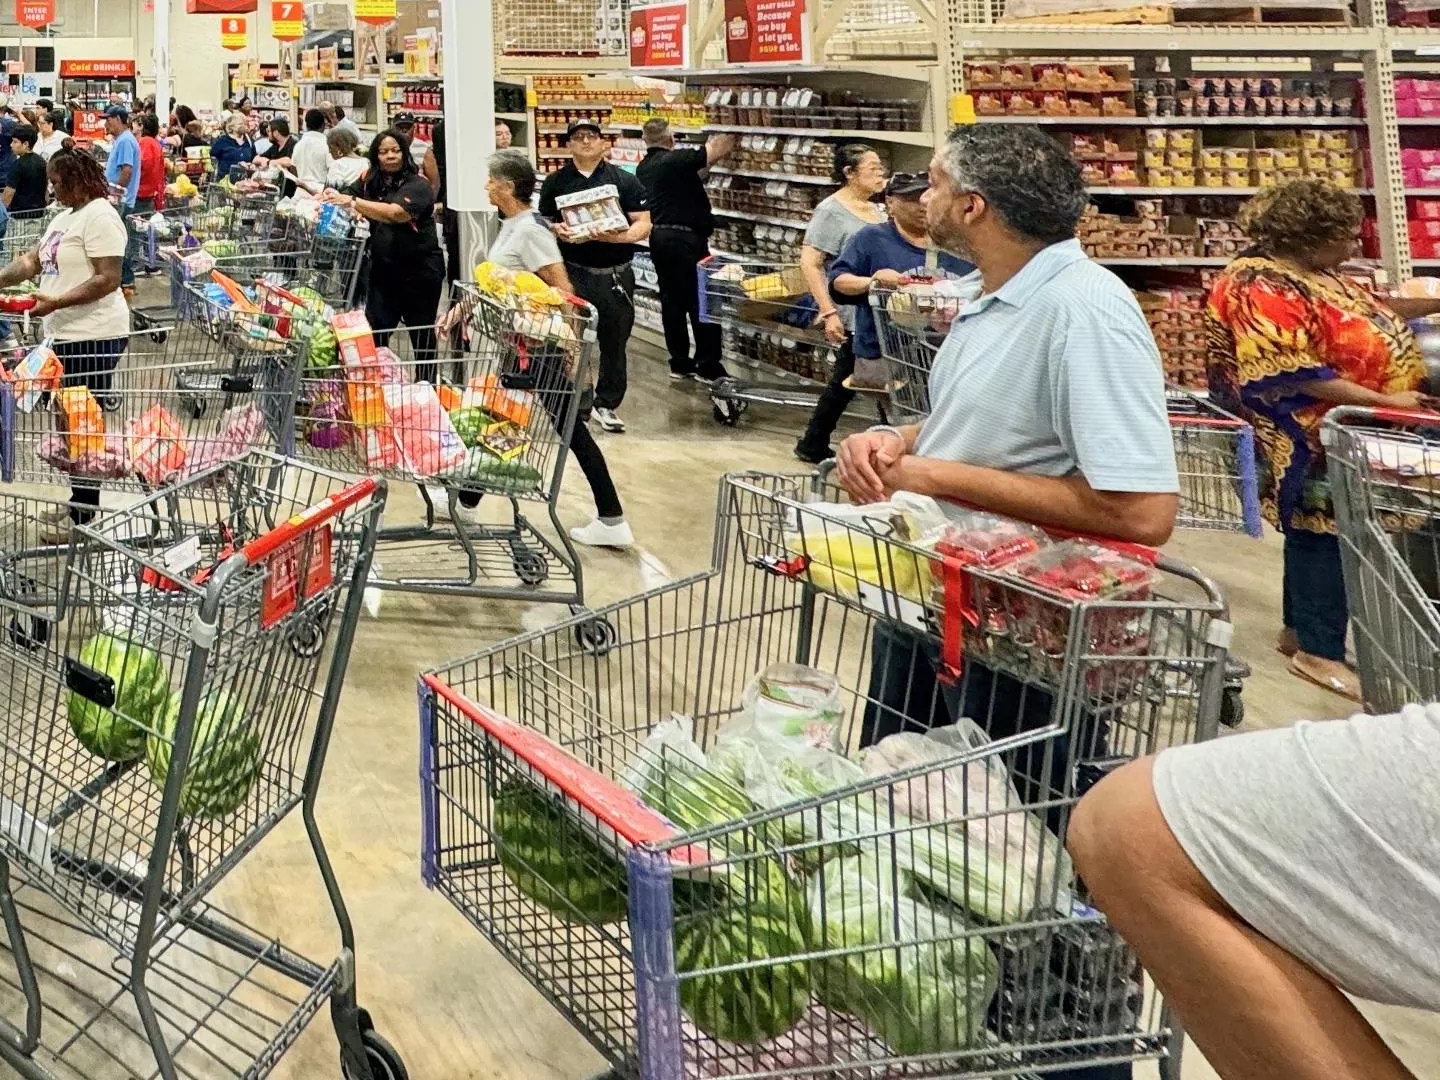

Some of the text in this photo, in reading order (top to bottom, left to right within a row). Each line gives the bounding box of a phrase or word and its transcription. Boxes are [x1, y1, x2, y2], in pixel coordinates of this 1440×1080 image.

[281, 4, 293, 19] 7
[757, 11, 792, 21] Because
[228, 20, 239, 32] 8
[757, 24, 769, 32] we
[771, 22, 787, 33] buy
[765, 33, 776, 42] lot
[70, 63, 91, 71] Cold
[81, 113, 96, 123] 10
